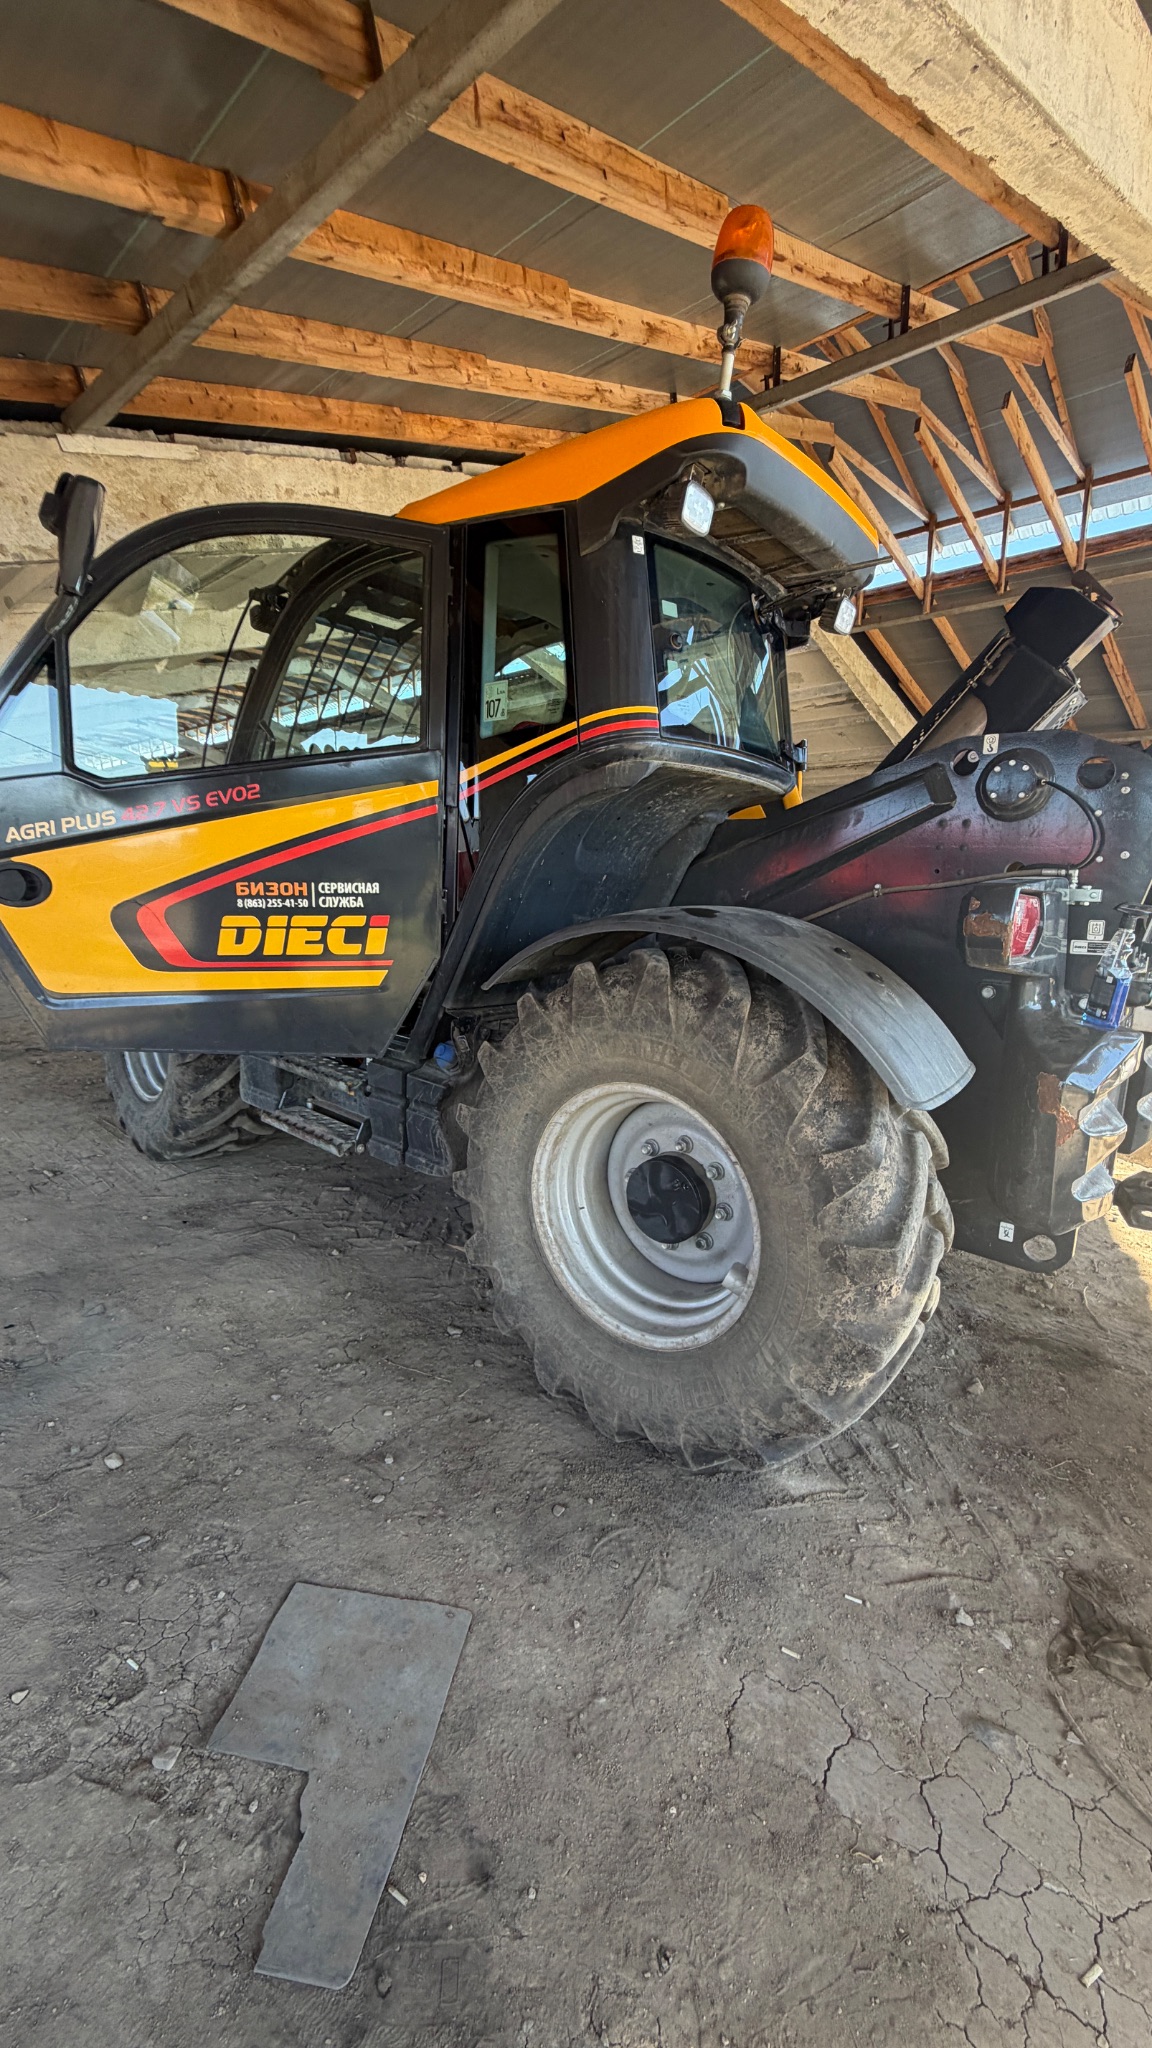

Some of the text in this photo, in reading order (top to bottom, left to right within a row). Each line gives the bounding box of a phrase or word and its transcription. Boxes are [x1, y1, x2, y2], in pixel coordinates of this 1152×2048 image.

[485, 698, 501, 719] 107
[5, 783, 261, 843] AGRI PLUS 42.7 VS EVO2
[235, 881, 308, 897] БИЗОН
[318, 881, 380, 895] СЕРВИСНАЯ
[236, 898, 309, 910] 8 (863) 255-41-50
[318, 896, 365, 909] СЛУЖБА
[217, 915, 391, 956] DIECI
